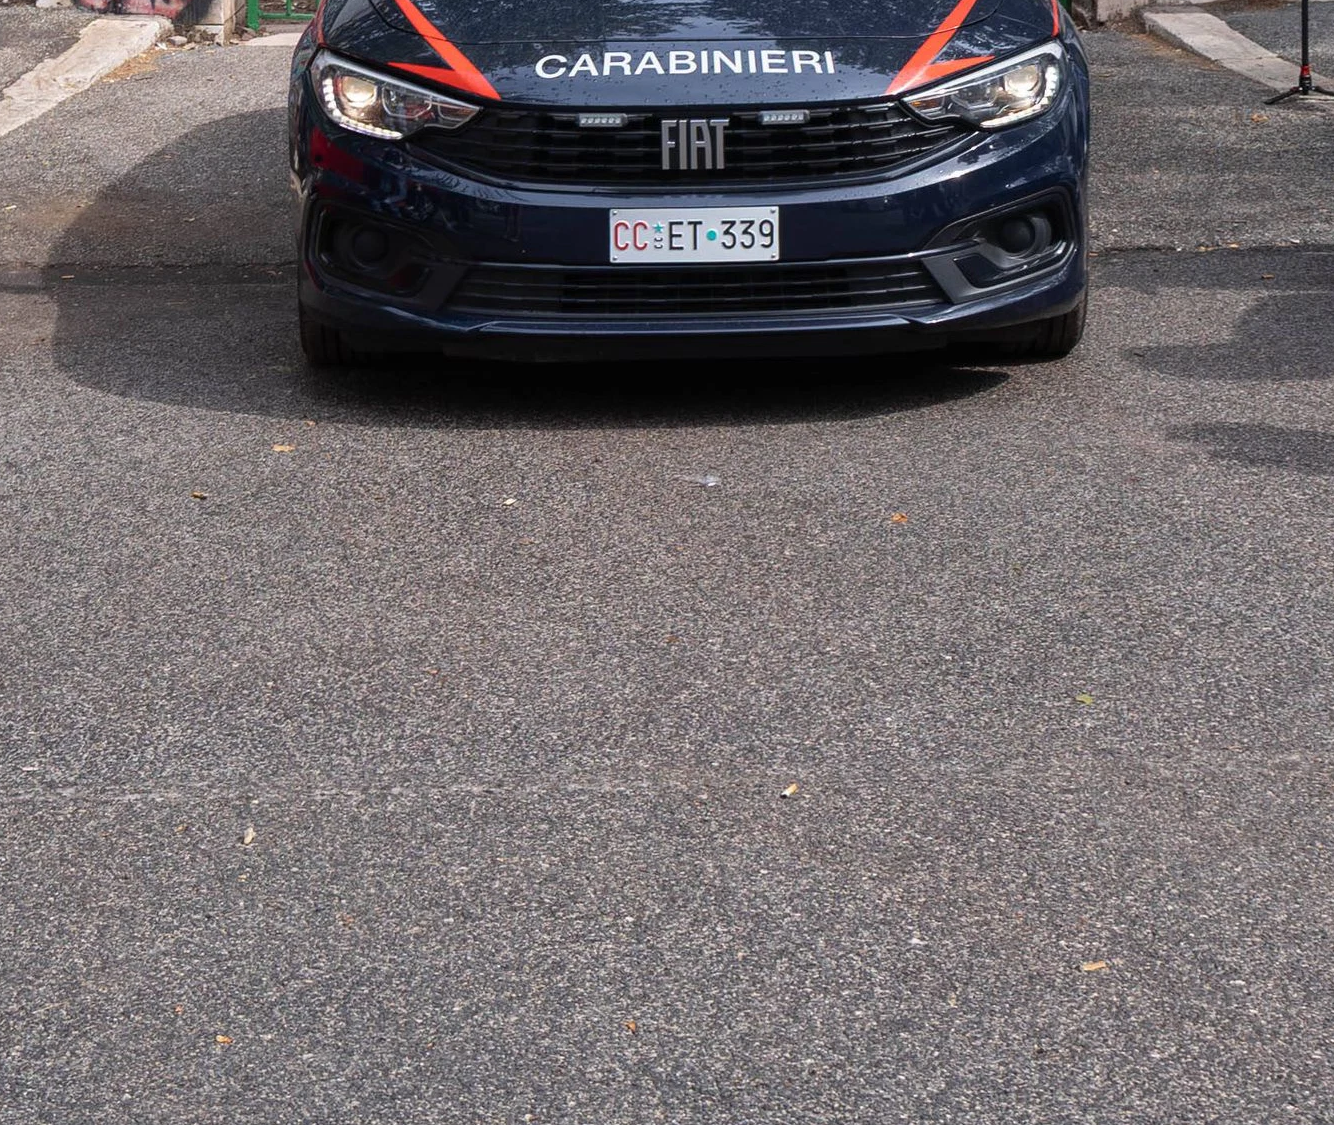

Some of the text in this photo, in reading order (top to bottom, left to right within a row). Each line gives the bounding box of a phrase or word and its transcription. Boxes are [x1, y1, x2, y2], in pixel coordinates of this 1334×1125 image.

[534, 50, 835, 79] CARABINIERI
[661, 119, 730, 170] FIAT
[721, 219, 775, 250] 339
